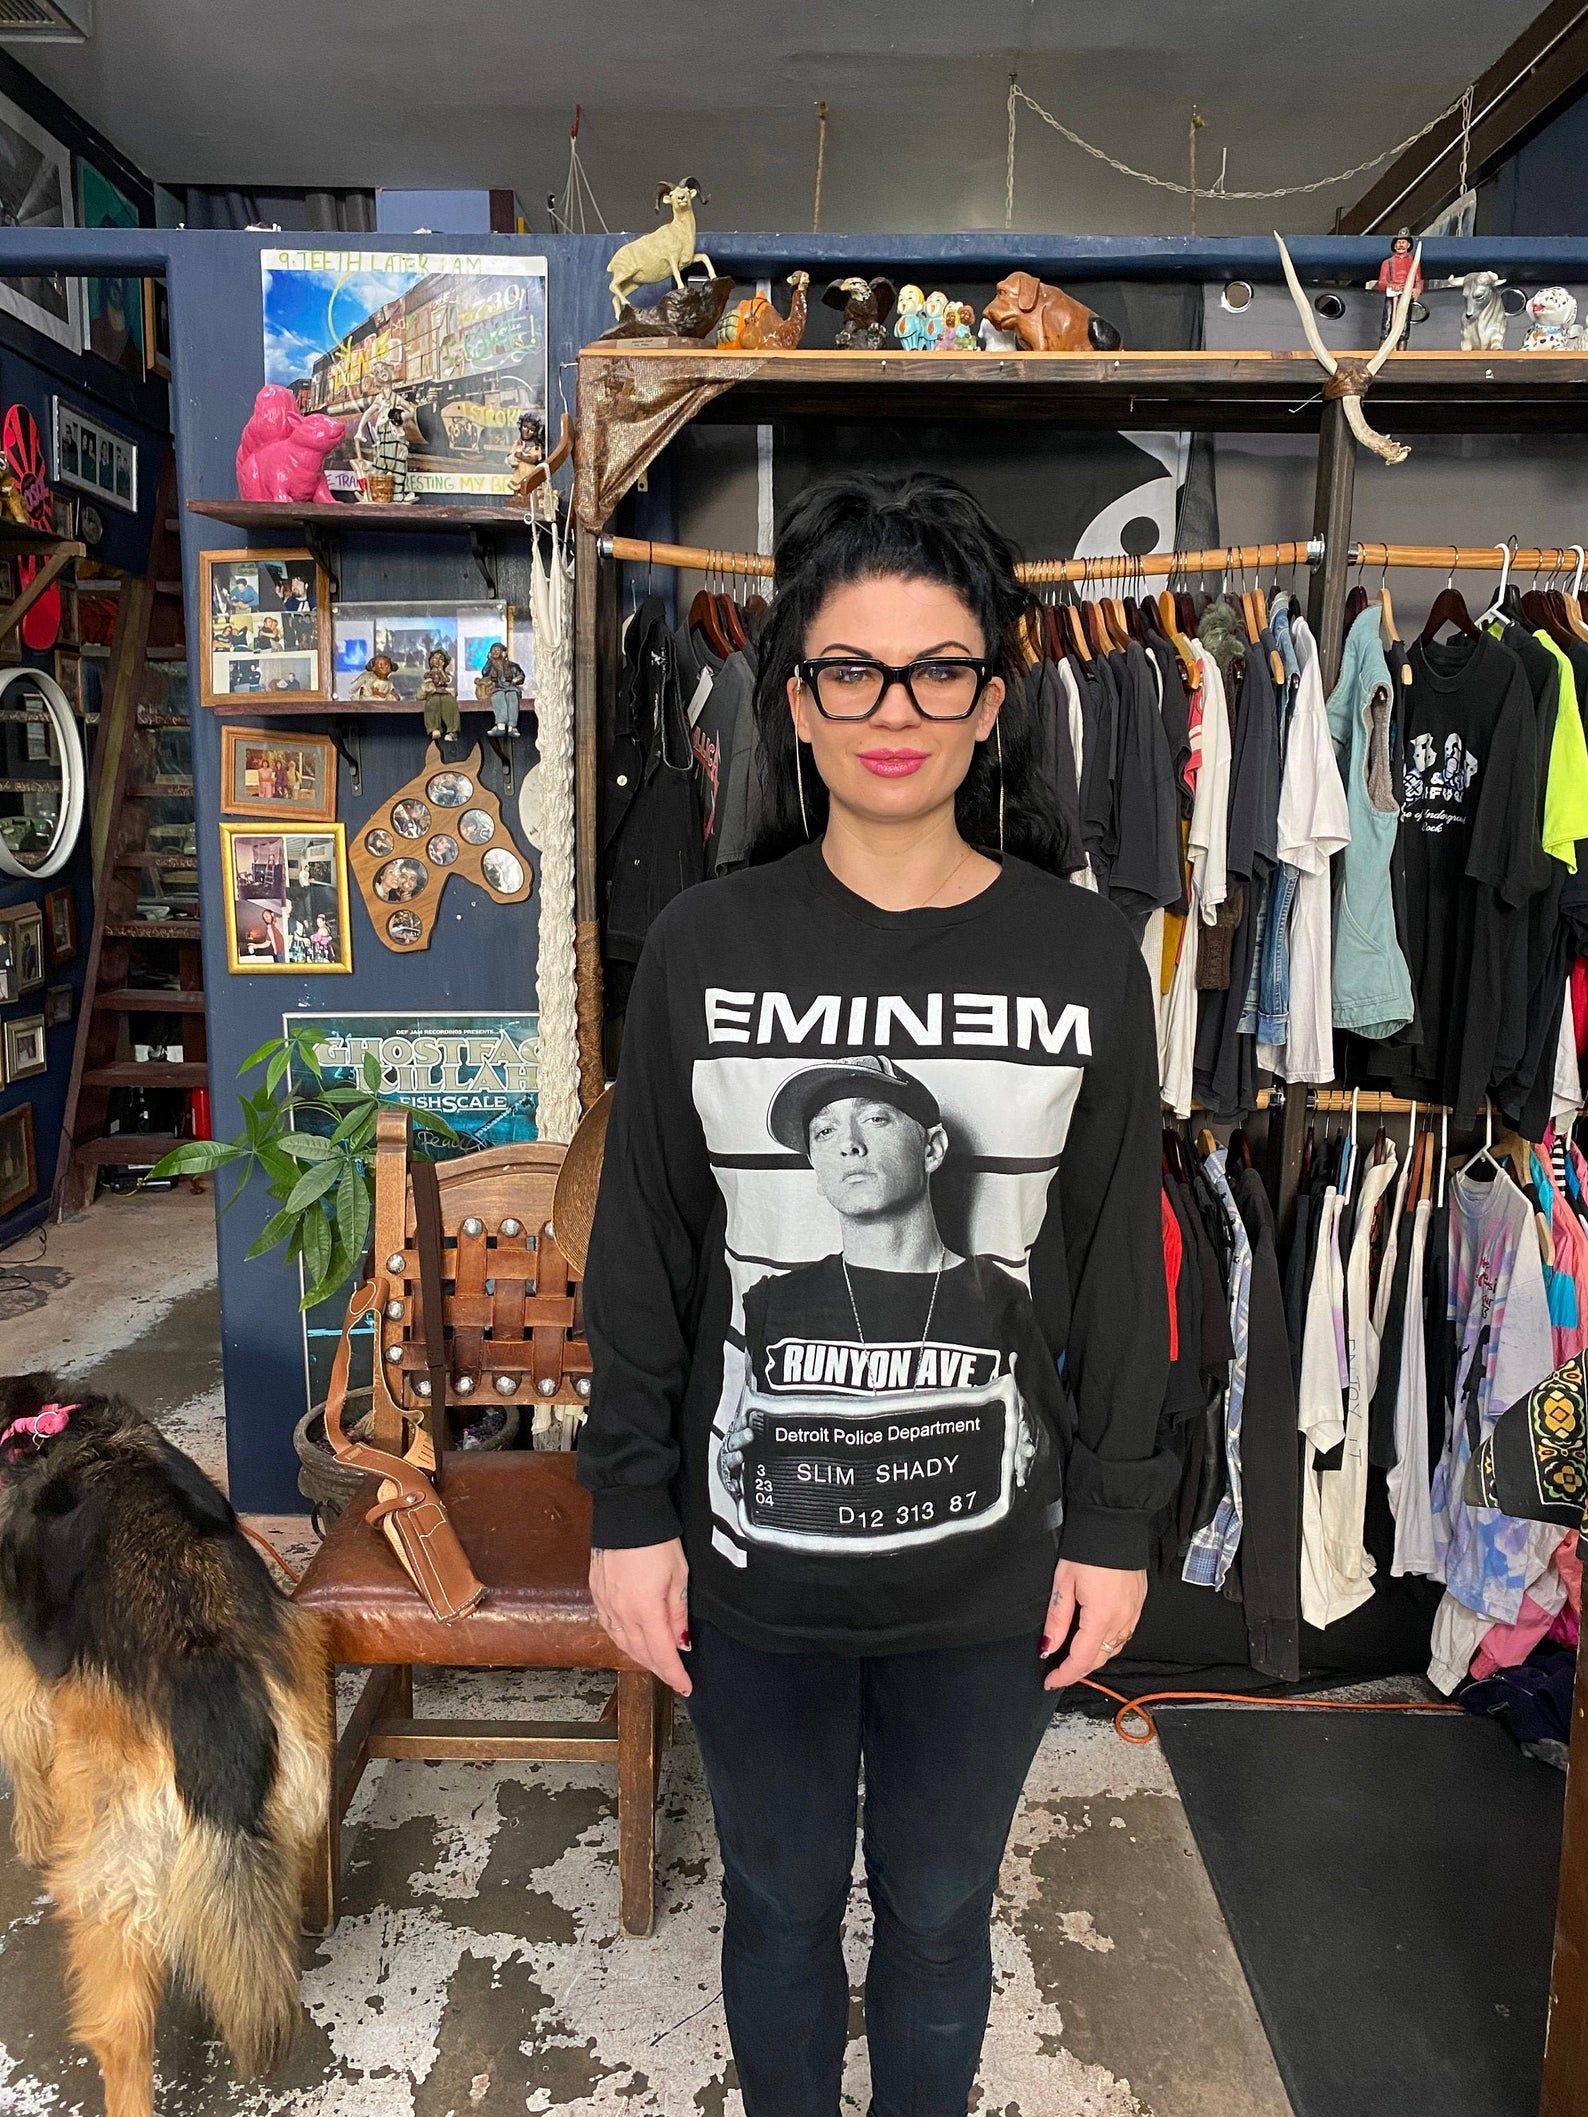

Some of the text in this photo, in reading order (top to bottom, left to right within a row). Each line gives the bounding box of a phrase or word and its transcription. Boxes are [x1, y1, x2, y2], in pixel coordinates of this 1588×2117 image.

[459, 477, 485, 493] MY
[705, 988, 1092, 1057] EMINEM
[313, 1030, 539, 1067] GHOSTFAC
[783, 1344, 912, 1388] RUNYON
[775, 1417, 981, 1446] Detroit Police Department
[1348, 1438, 1362, 1466] IT
[756, 1465, 766, 1477] 3
[796, 1455, 960, 1485] SLIM SHADY
[755, 1479, 773, 1492] 23
[755, 1494, 774, 1507] 04
[839, 1491, 977, 1528] D12 313 87
